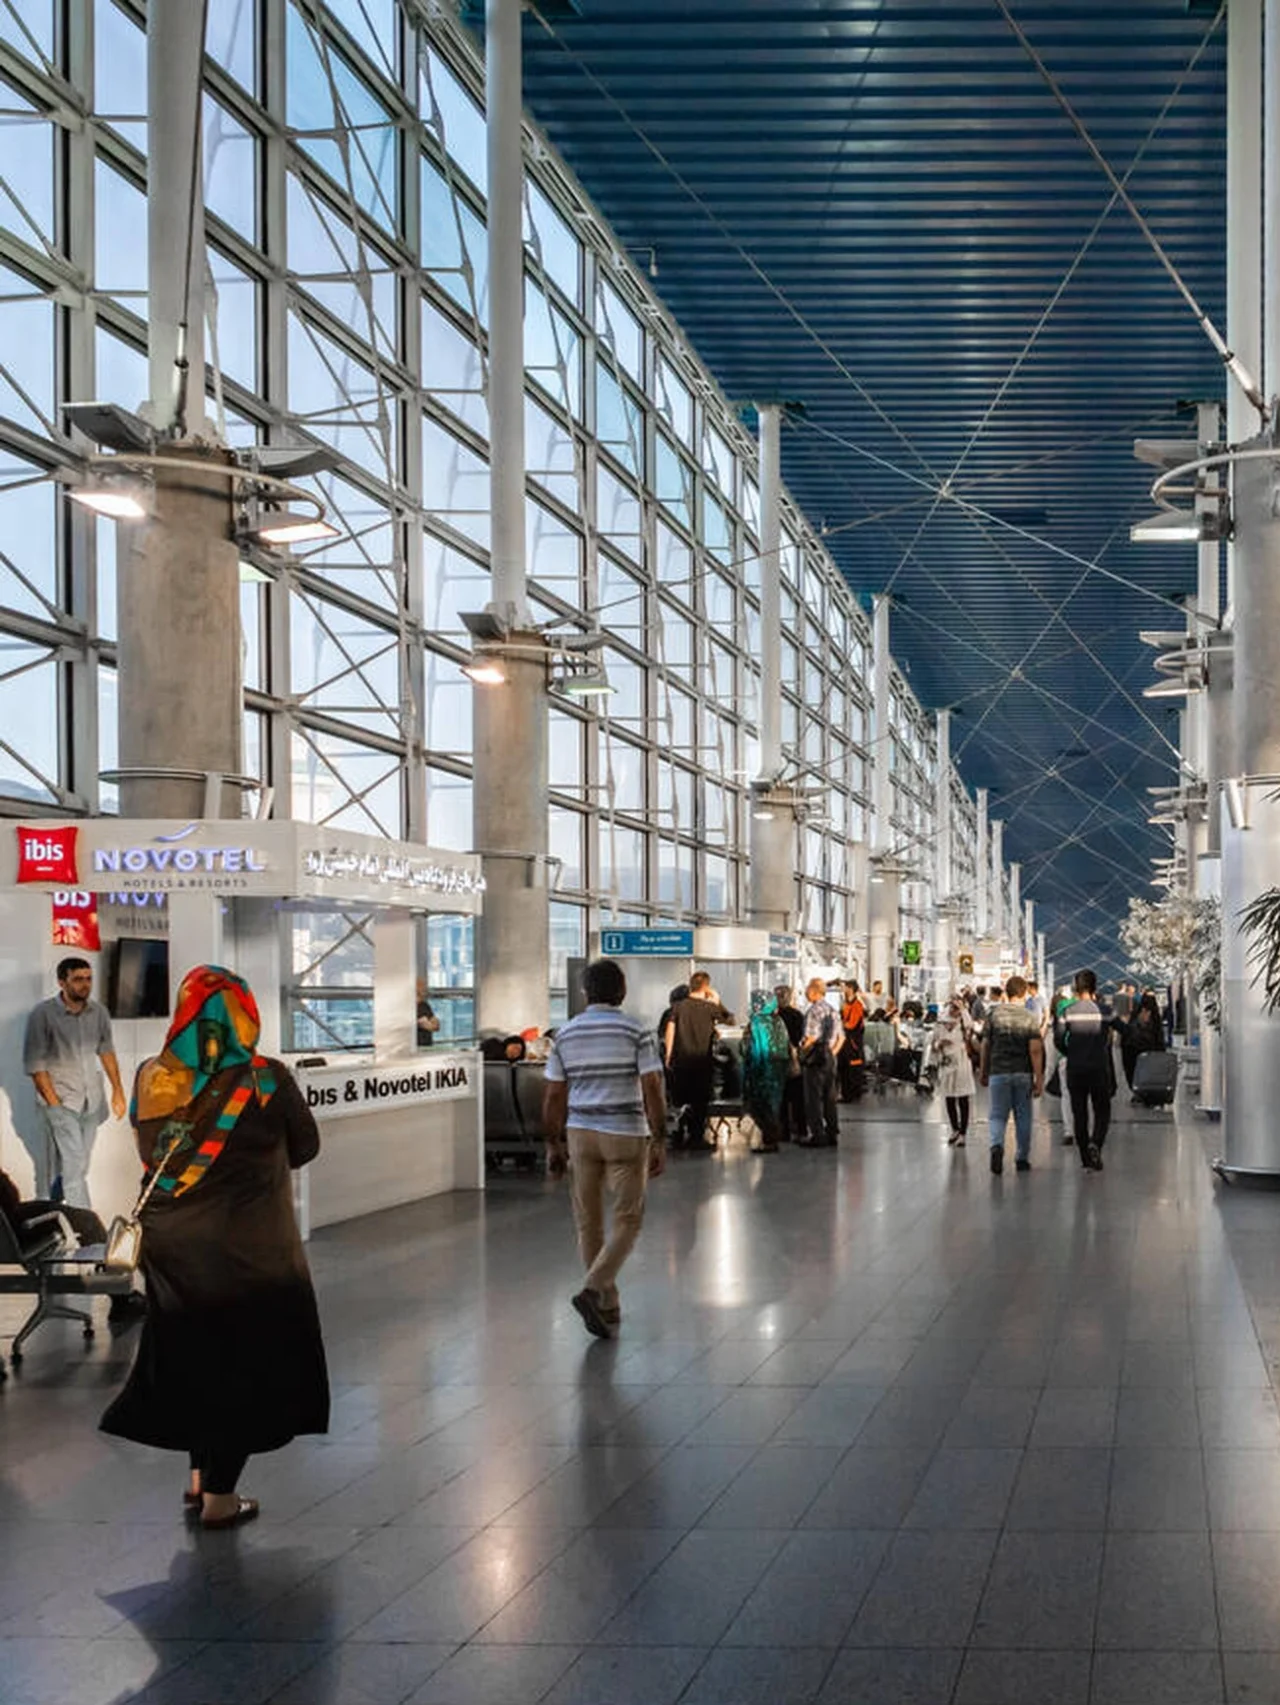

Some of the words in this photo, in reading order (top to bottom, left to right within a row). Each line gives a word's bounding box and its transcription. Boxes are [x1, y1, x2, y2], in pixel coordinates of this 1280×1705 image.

[25, 838, 64, 861] ibis
[94, 847, 267, 873] NOVOTEL
[123, 879, 173, 888] HOTELS
[178, 879, 185, 888] &
[190, 879, 248, 888] RESORTS
[306, 1085, 338, 1108] bis
[343, 1080, 359, 1102] &
[364, 1071, 431, 1100] Novotel
[435, 1067, 468, 1090] IKIA
